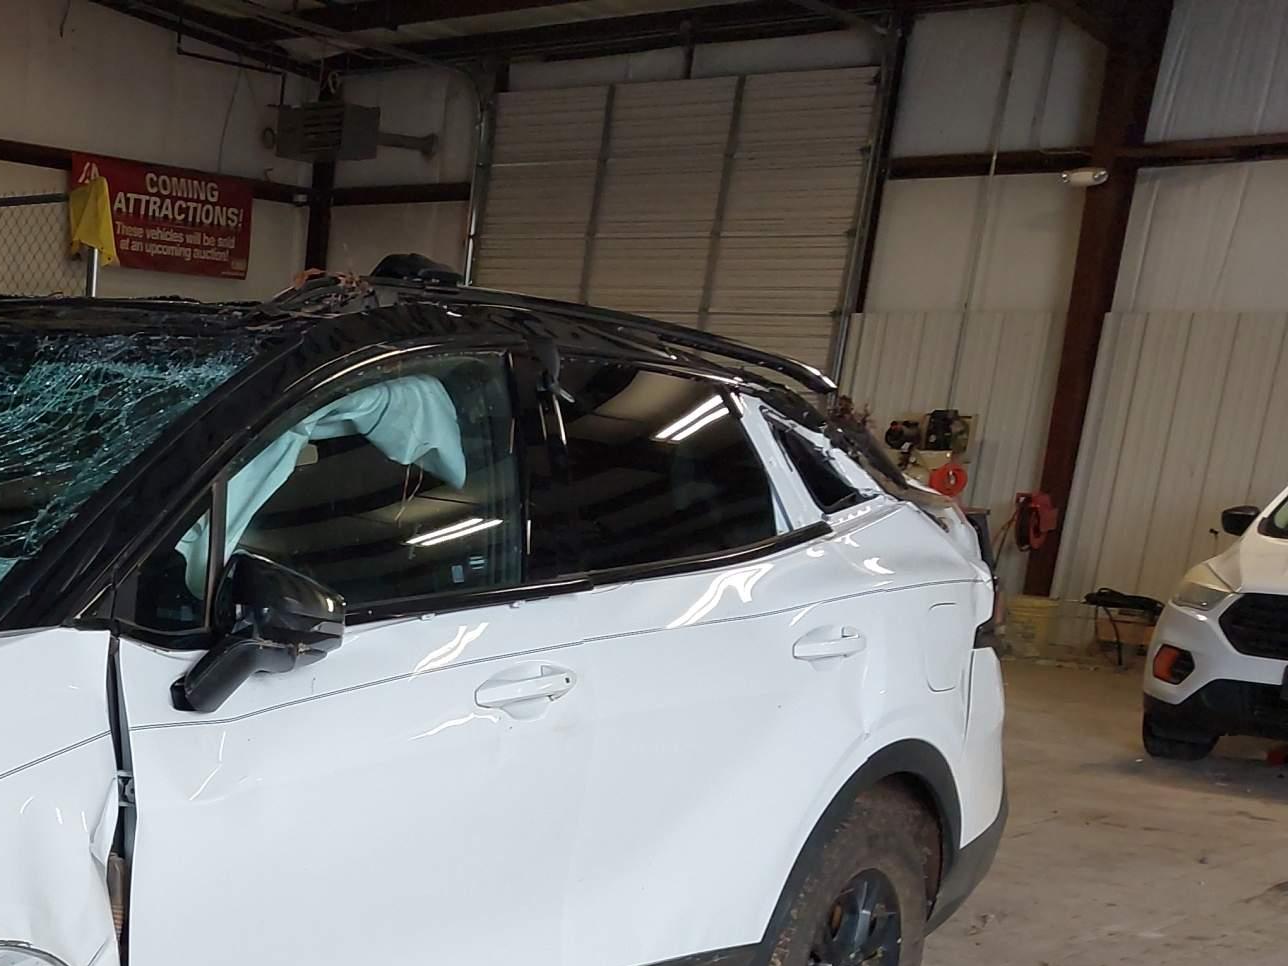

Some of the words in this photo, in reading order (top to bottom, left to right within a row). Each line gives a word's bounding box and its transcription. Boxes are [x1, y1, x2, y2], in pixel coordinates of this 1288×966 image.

[145, 172, 219, 202] COMING
[113, 191, 244, 228] ATTRACTIONS!
[114, 221, 145, 238] These
[146, 227, 185, 243] vehicles
[186, 231, 202, 245] will
[203, 233, 216, 247] be
[217, 235, 236, 249] sold
[119, 238, 130, 250] at
[130, 241, 144, 252] an
[145, 241, 192, 261] upcoming
[193, 247, 230, 262] auction!
